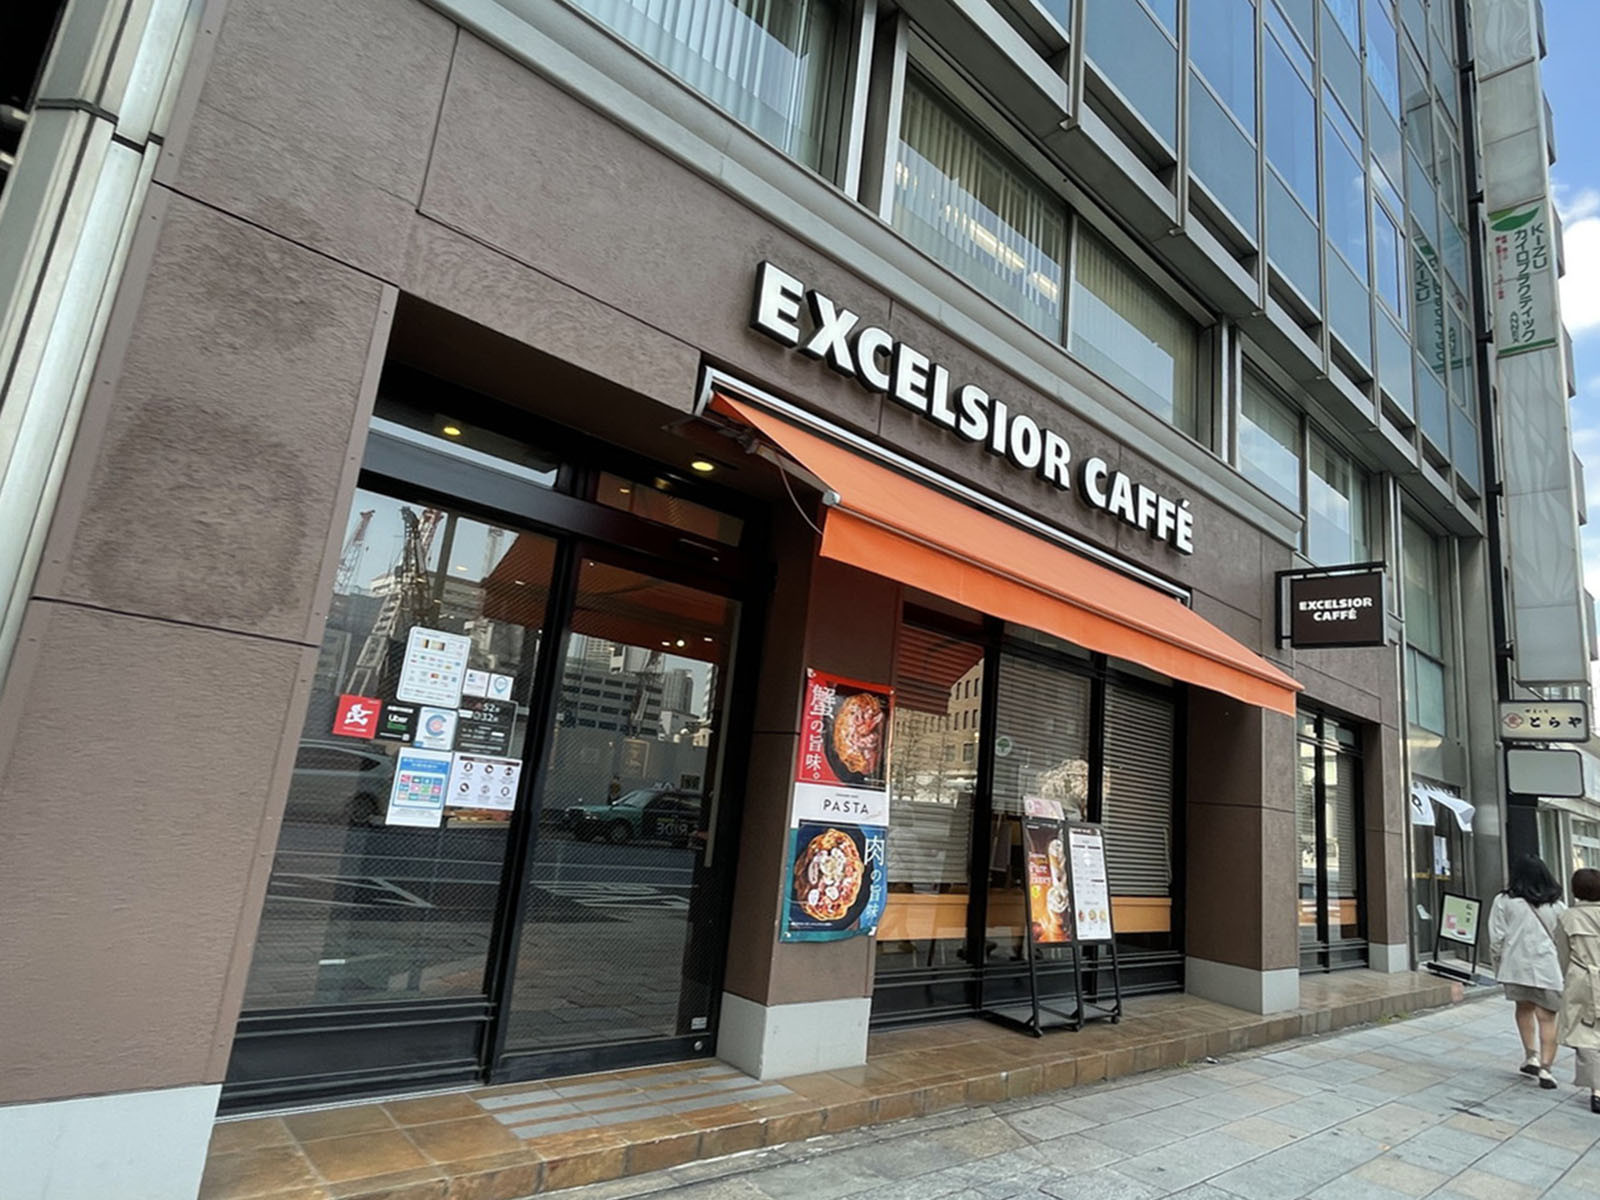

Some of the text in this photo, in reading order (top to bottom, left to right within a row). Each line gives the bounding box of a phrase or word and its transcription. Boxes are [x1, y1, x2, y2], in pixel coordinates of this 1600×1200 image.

[1531, 222, 1547, 269] KIZU
[1514, 229, 1535, 343] カイロプラクティック
[755, 259, 1195, 556] EXCELSIOR CAFFÉ
[1298, 597, 1372, 610] EXCELSIOR
[1313, 609, 1357, 621] CAFFÉ
[805, 684, 837, 780] 蟹の旨味。
[1529, 715, 1583, 729] とらや
[822, 798, 870, 815] PASTA
